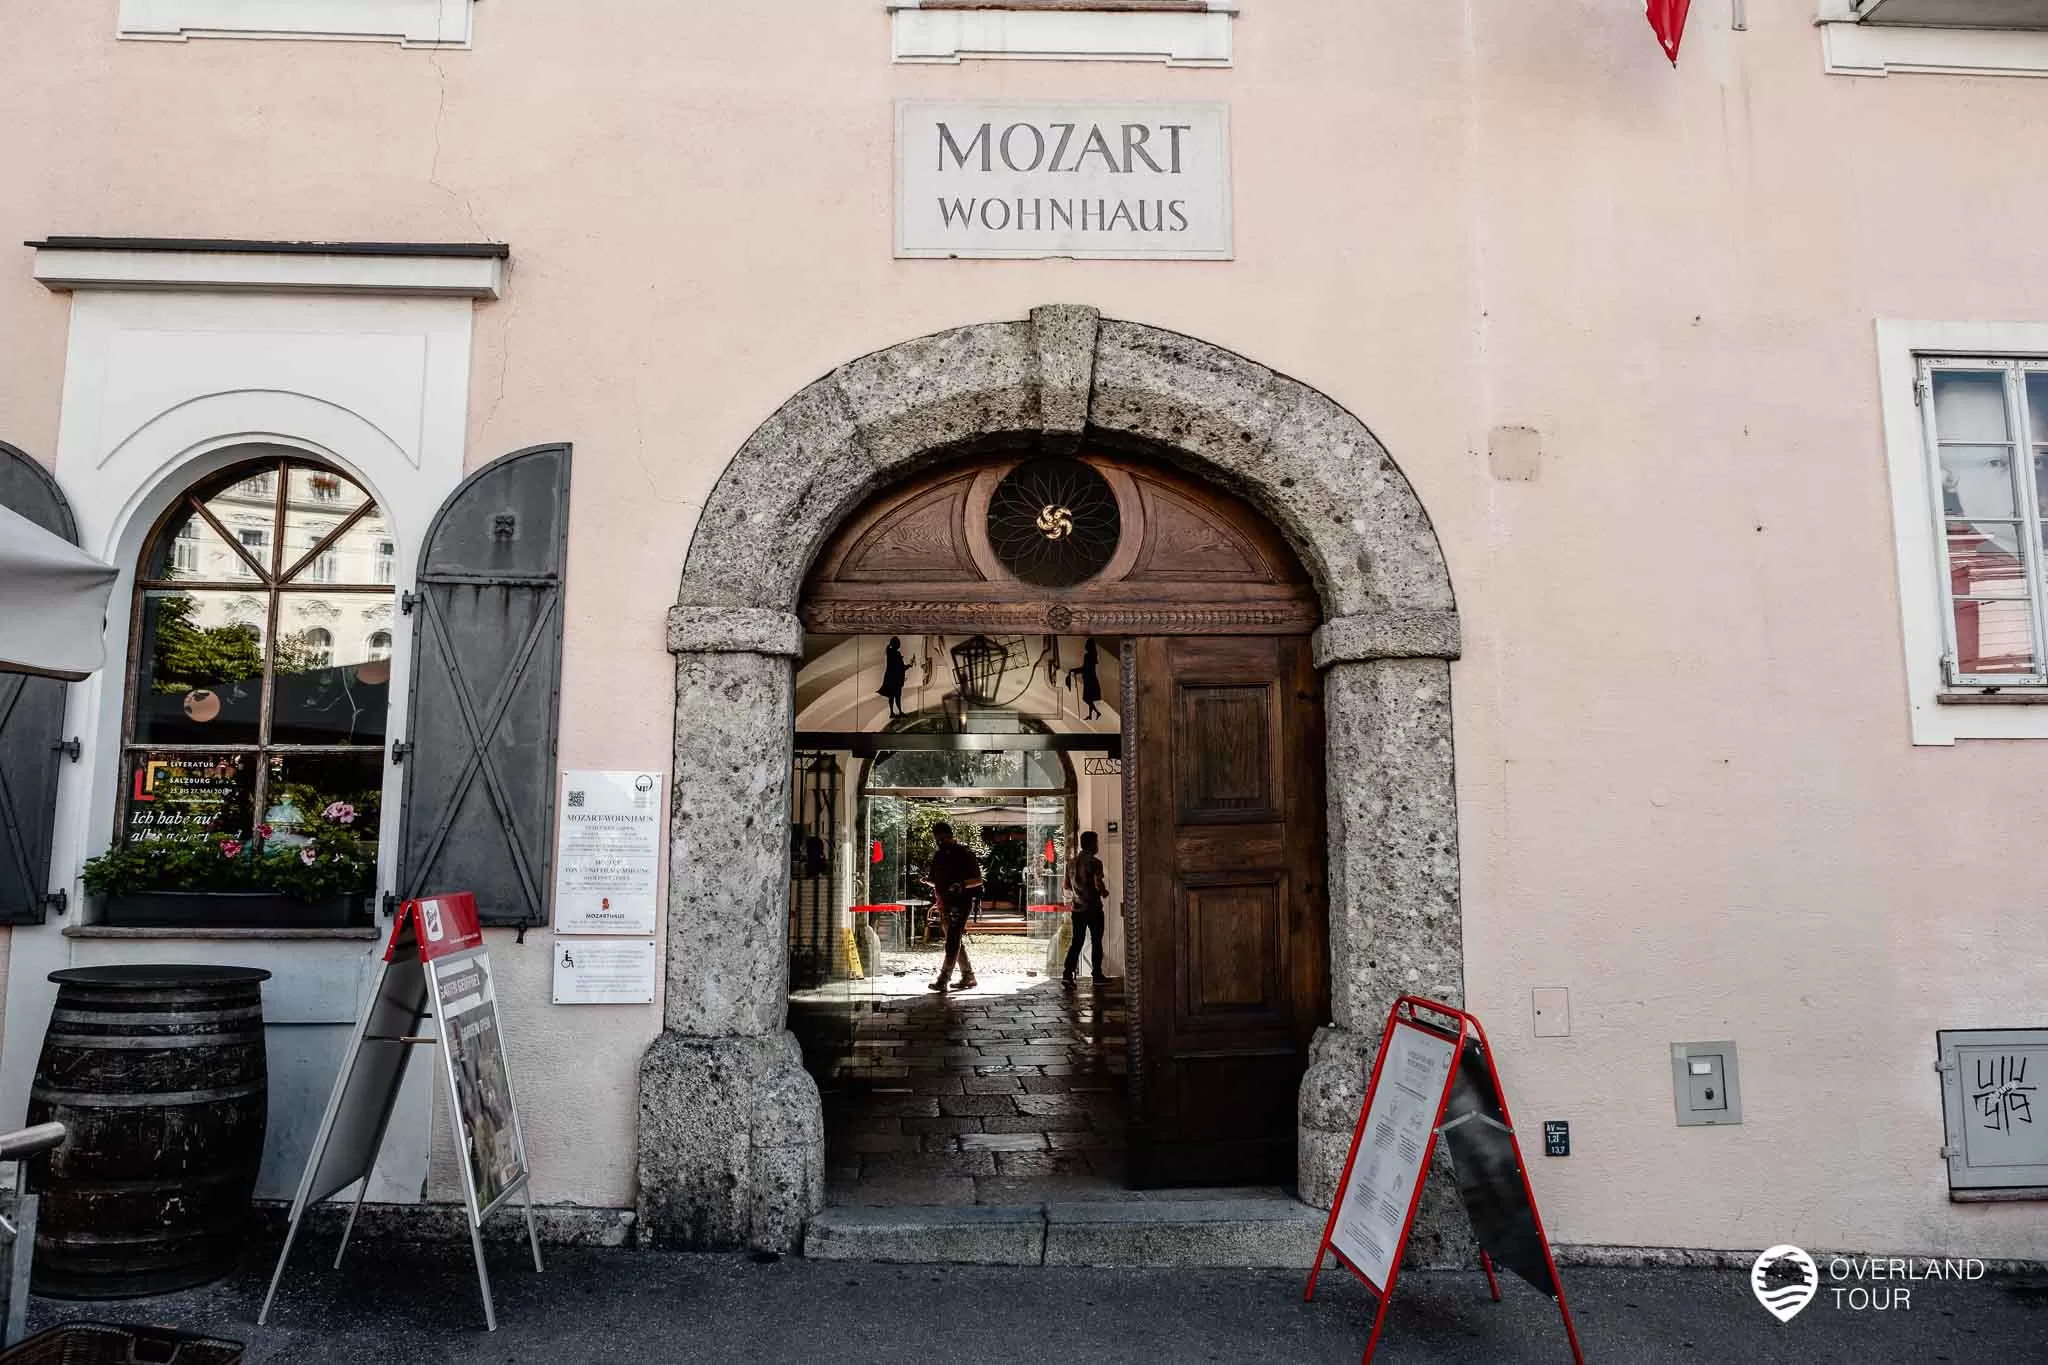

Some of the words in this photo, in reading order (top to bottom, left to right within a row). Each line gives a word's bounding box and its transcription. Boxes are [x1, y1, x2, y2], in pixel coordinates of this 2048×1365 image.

[936, 122, 1191, 174] MOZART
[937, 197, 1190, 232] WOHNHAUS
[131, 811, 154, 825] Ich
[193, 811, 222, 825] auf
